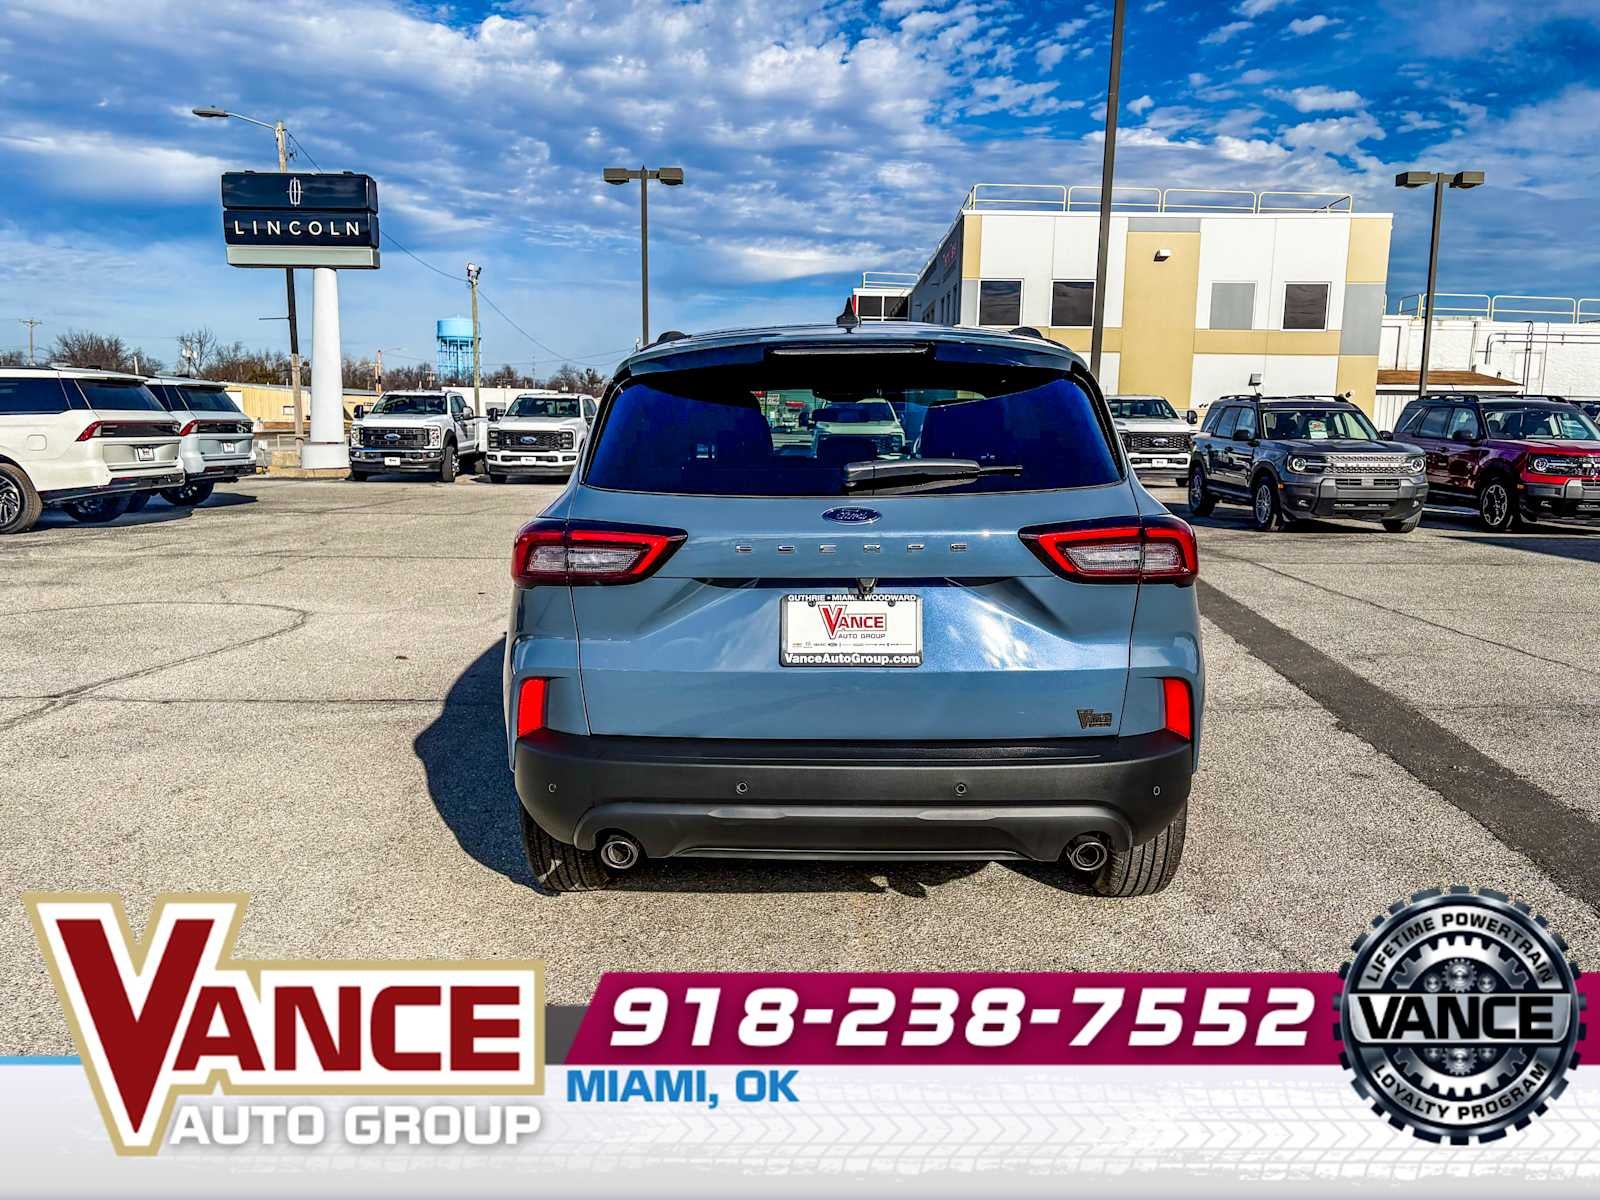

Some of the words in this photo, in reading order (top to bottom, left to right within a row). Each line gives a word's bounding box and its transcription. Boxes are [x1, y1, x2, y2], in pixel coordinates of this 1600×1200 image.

[234, 220, 360, 236] LINCOLN
[787, 594, 826, 602] GUTHRIE
[865, 594, 917, 602] WOODWARD
[822, 607, 884, 637] VANCE
[785, 653, 921, 666] VanceAutoGroup.com
